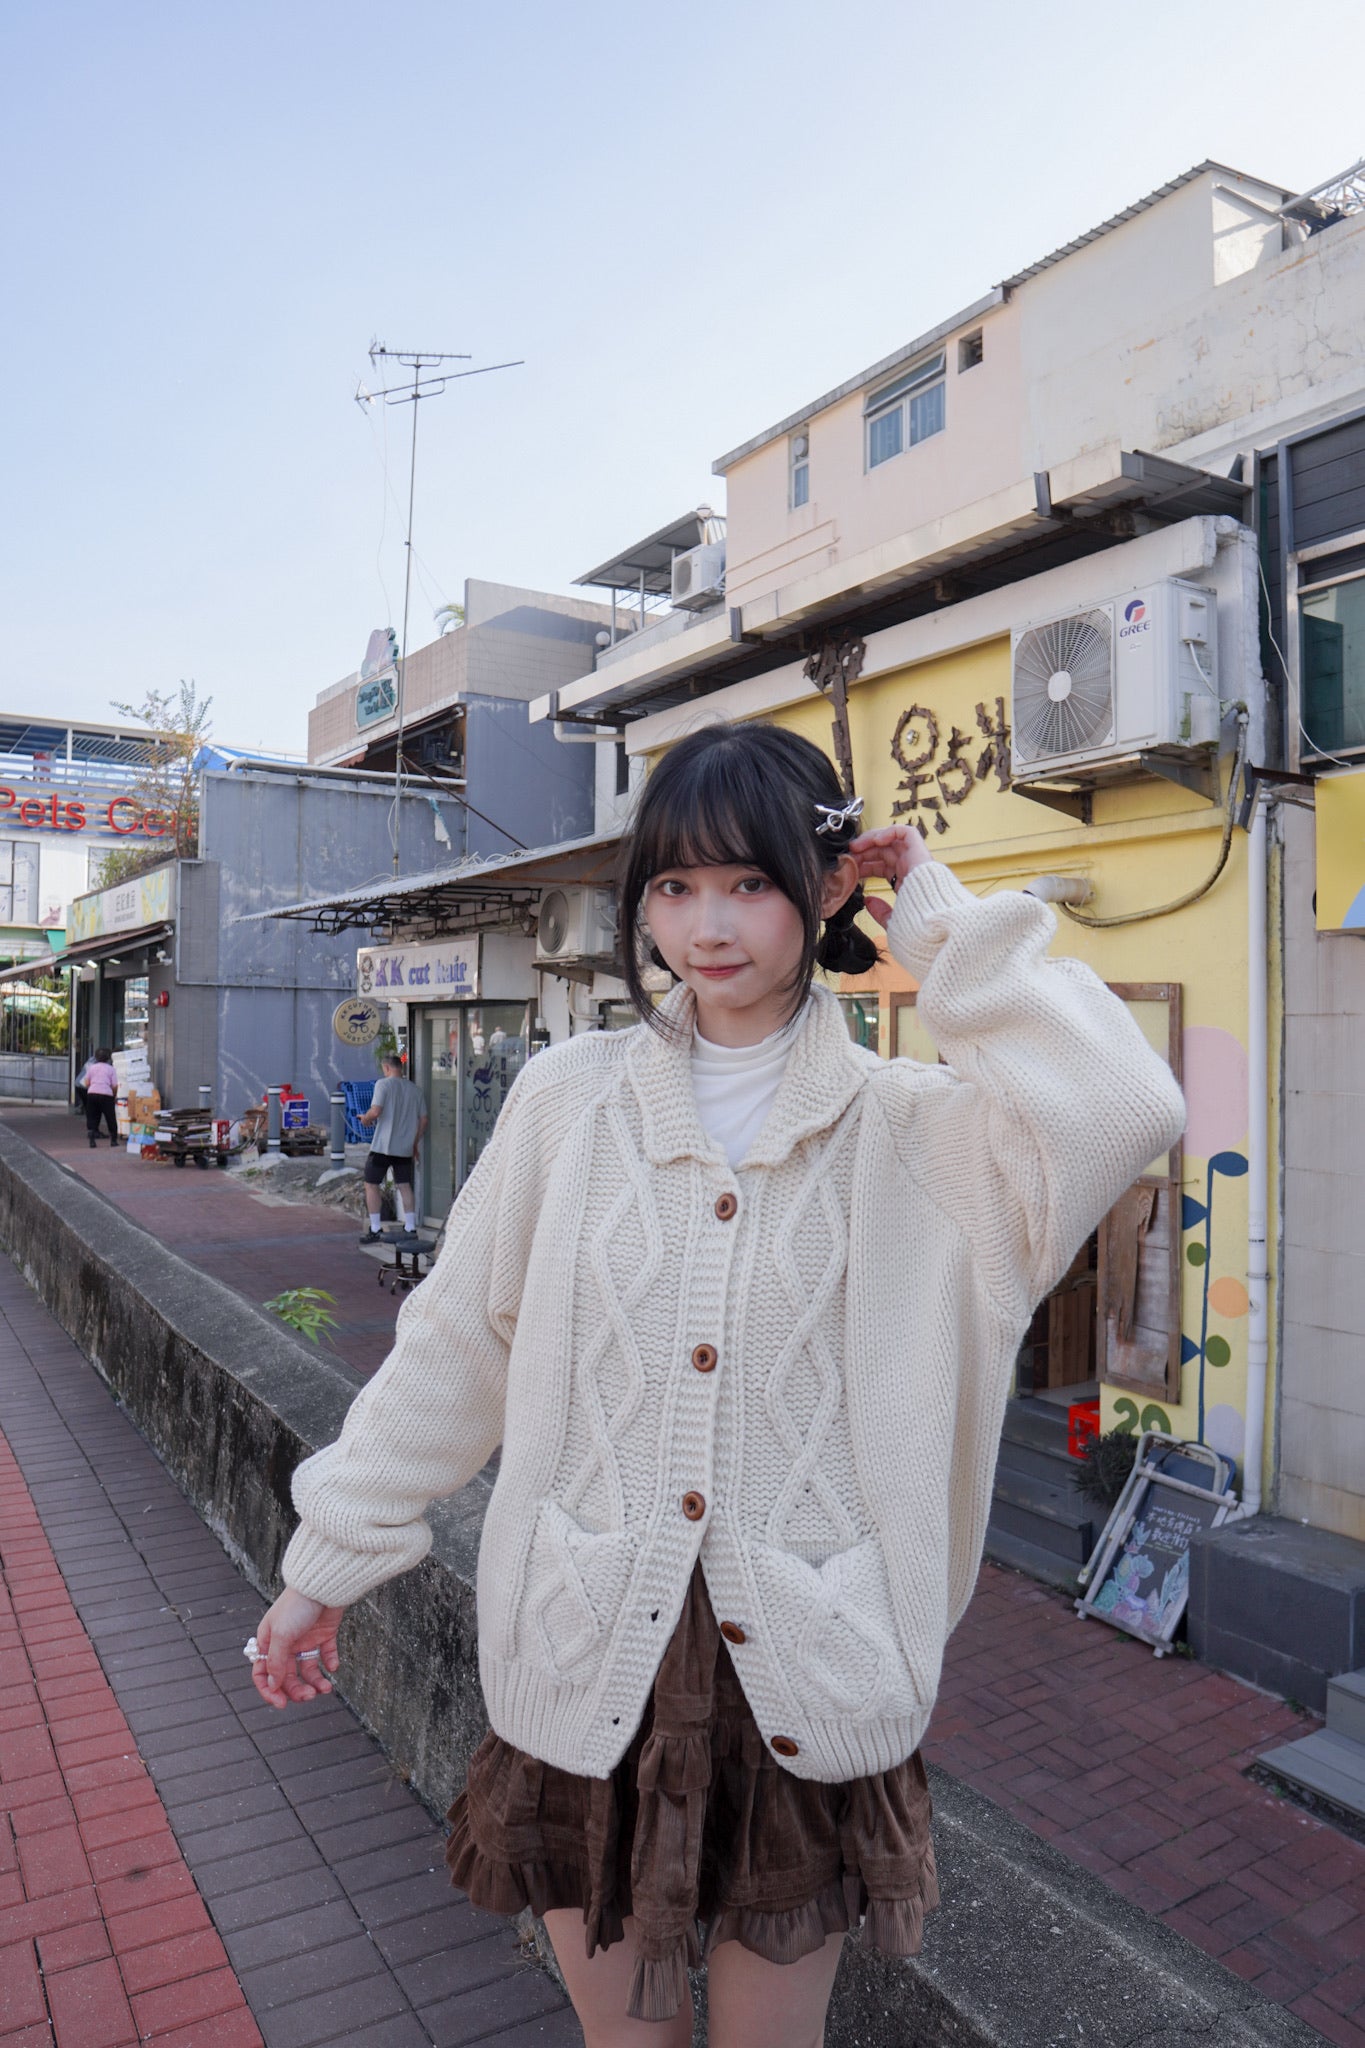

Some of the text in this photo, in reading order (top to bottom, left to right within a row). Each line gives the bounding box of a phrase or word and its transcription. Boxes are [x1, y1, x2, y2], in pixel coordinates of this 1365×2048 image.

[1120, 620, 1151, 638] GREE
[0, 787, 86, 830] Pets
[408, 963, 430, 985] cut
[435, 955, 467, 985] hair
[348, 1002, 362, 1010] CUT
